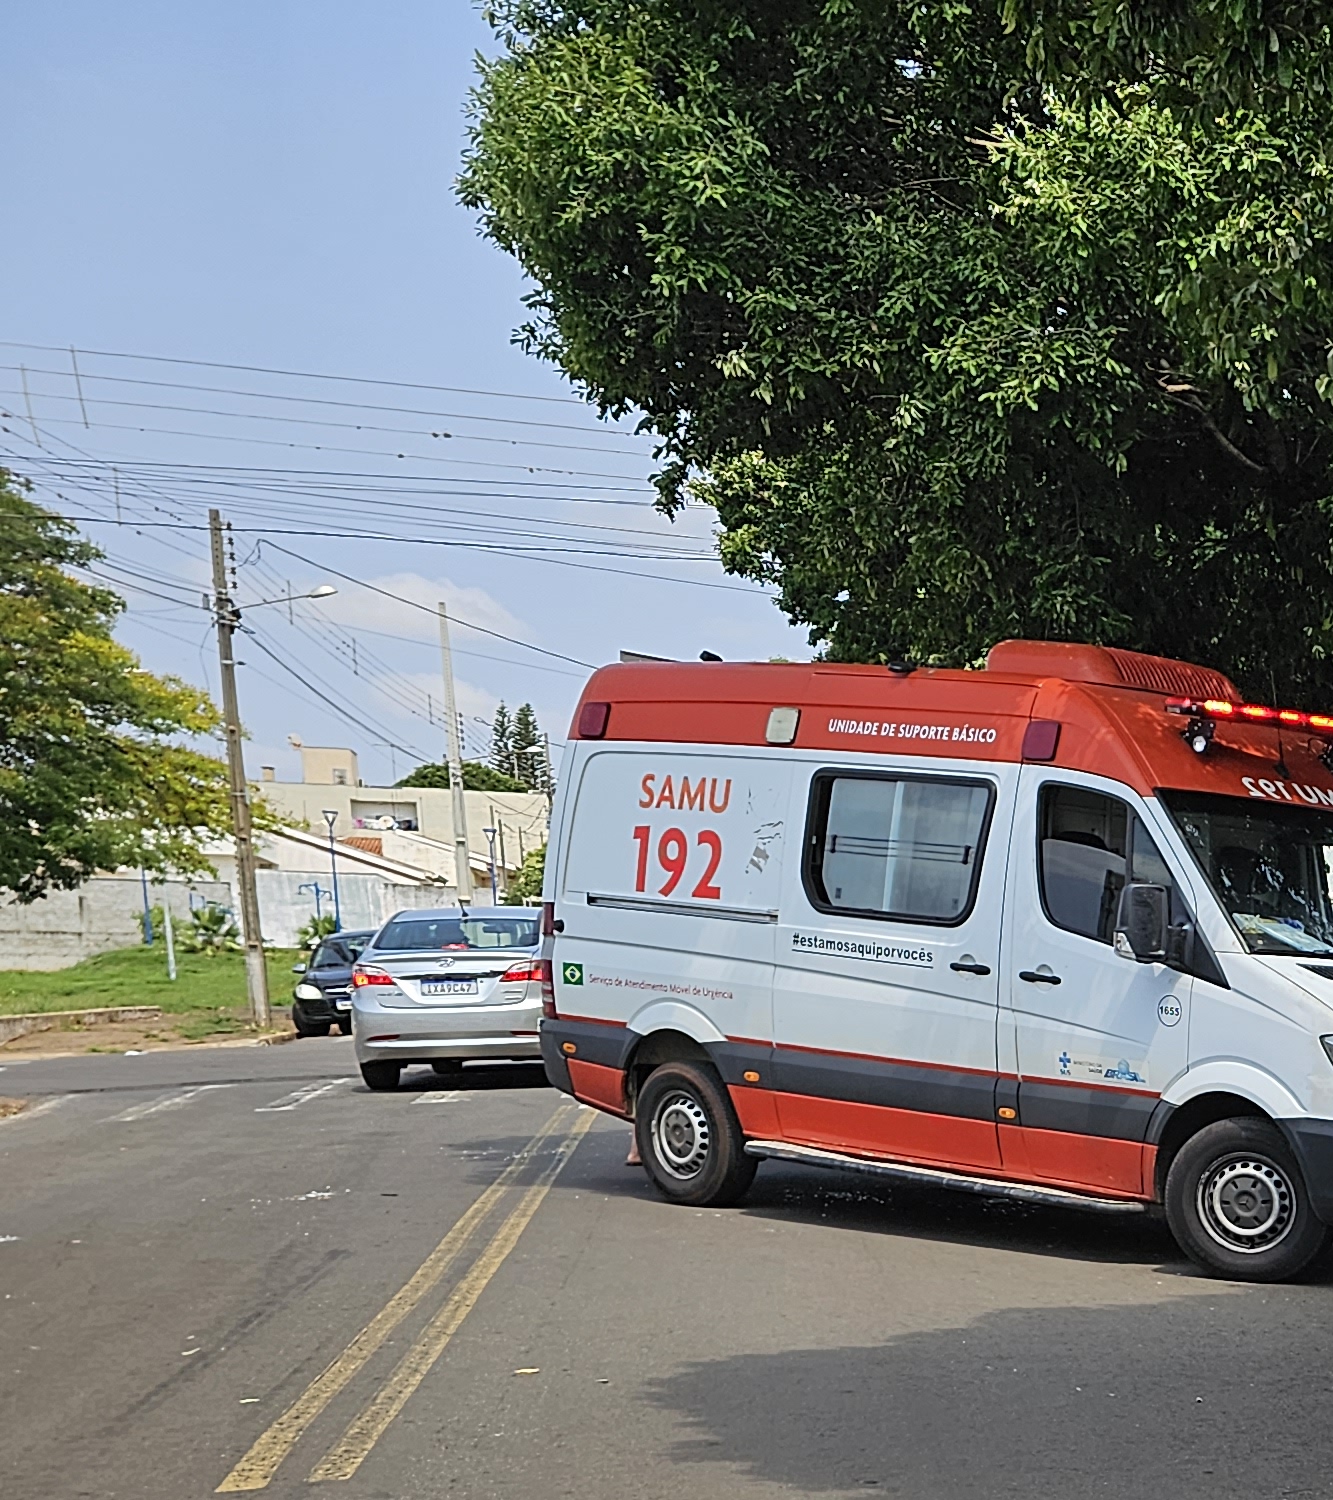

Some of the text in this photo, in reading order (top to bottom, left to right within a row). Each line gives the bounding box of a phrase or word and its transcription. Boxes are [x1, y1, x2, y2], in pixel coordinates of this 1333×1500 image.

[828, 718, 997, 743] UNIDADE DE SUPORTE BÁSICO
[639, 773, 731, 814] SAMU
[633, 825, 722, 900] 192
[792, 931, 933, 963] #estamosaquiporvocês
[624, 978, 668, 992] Atendimento
[1160, 1005, 1179, 1016] 1655
